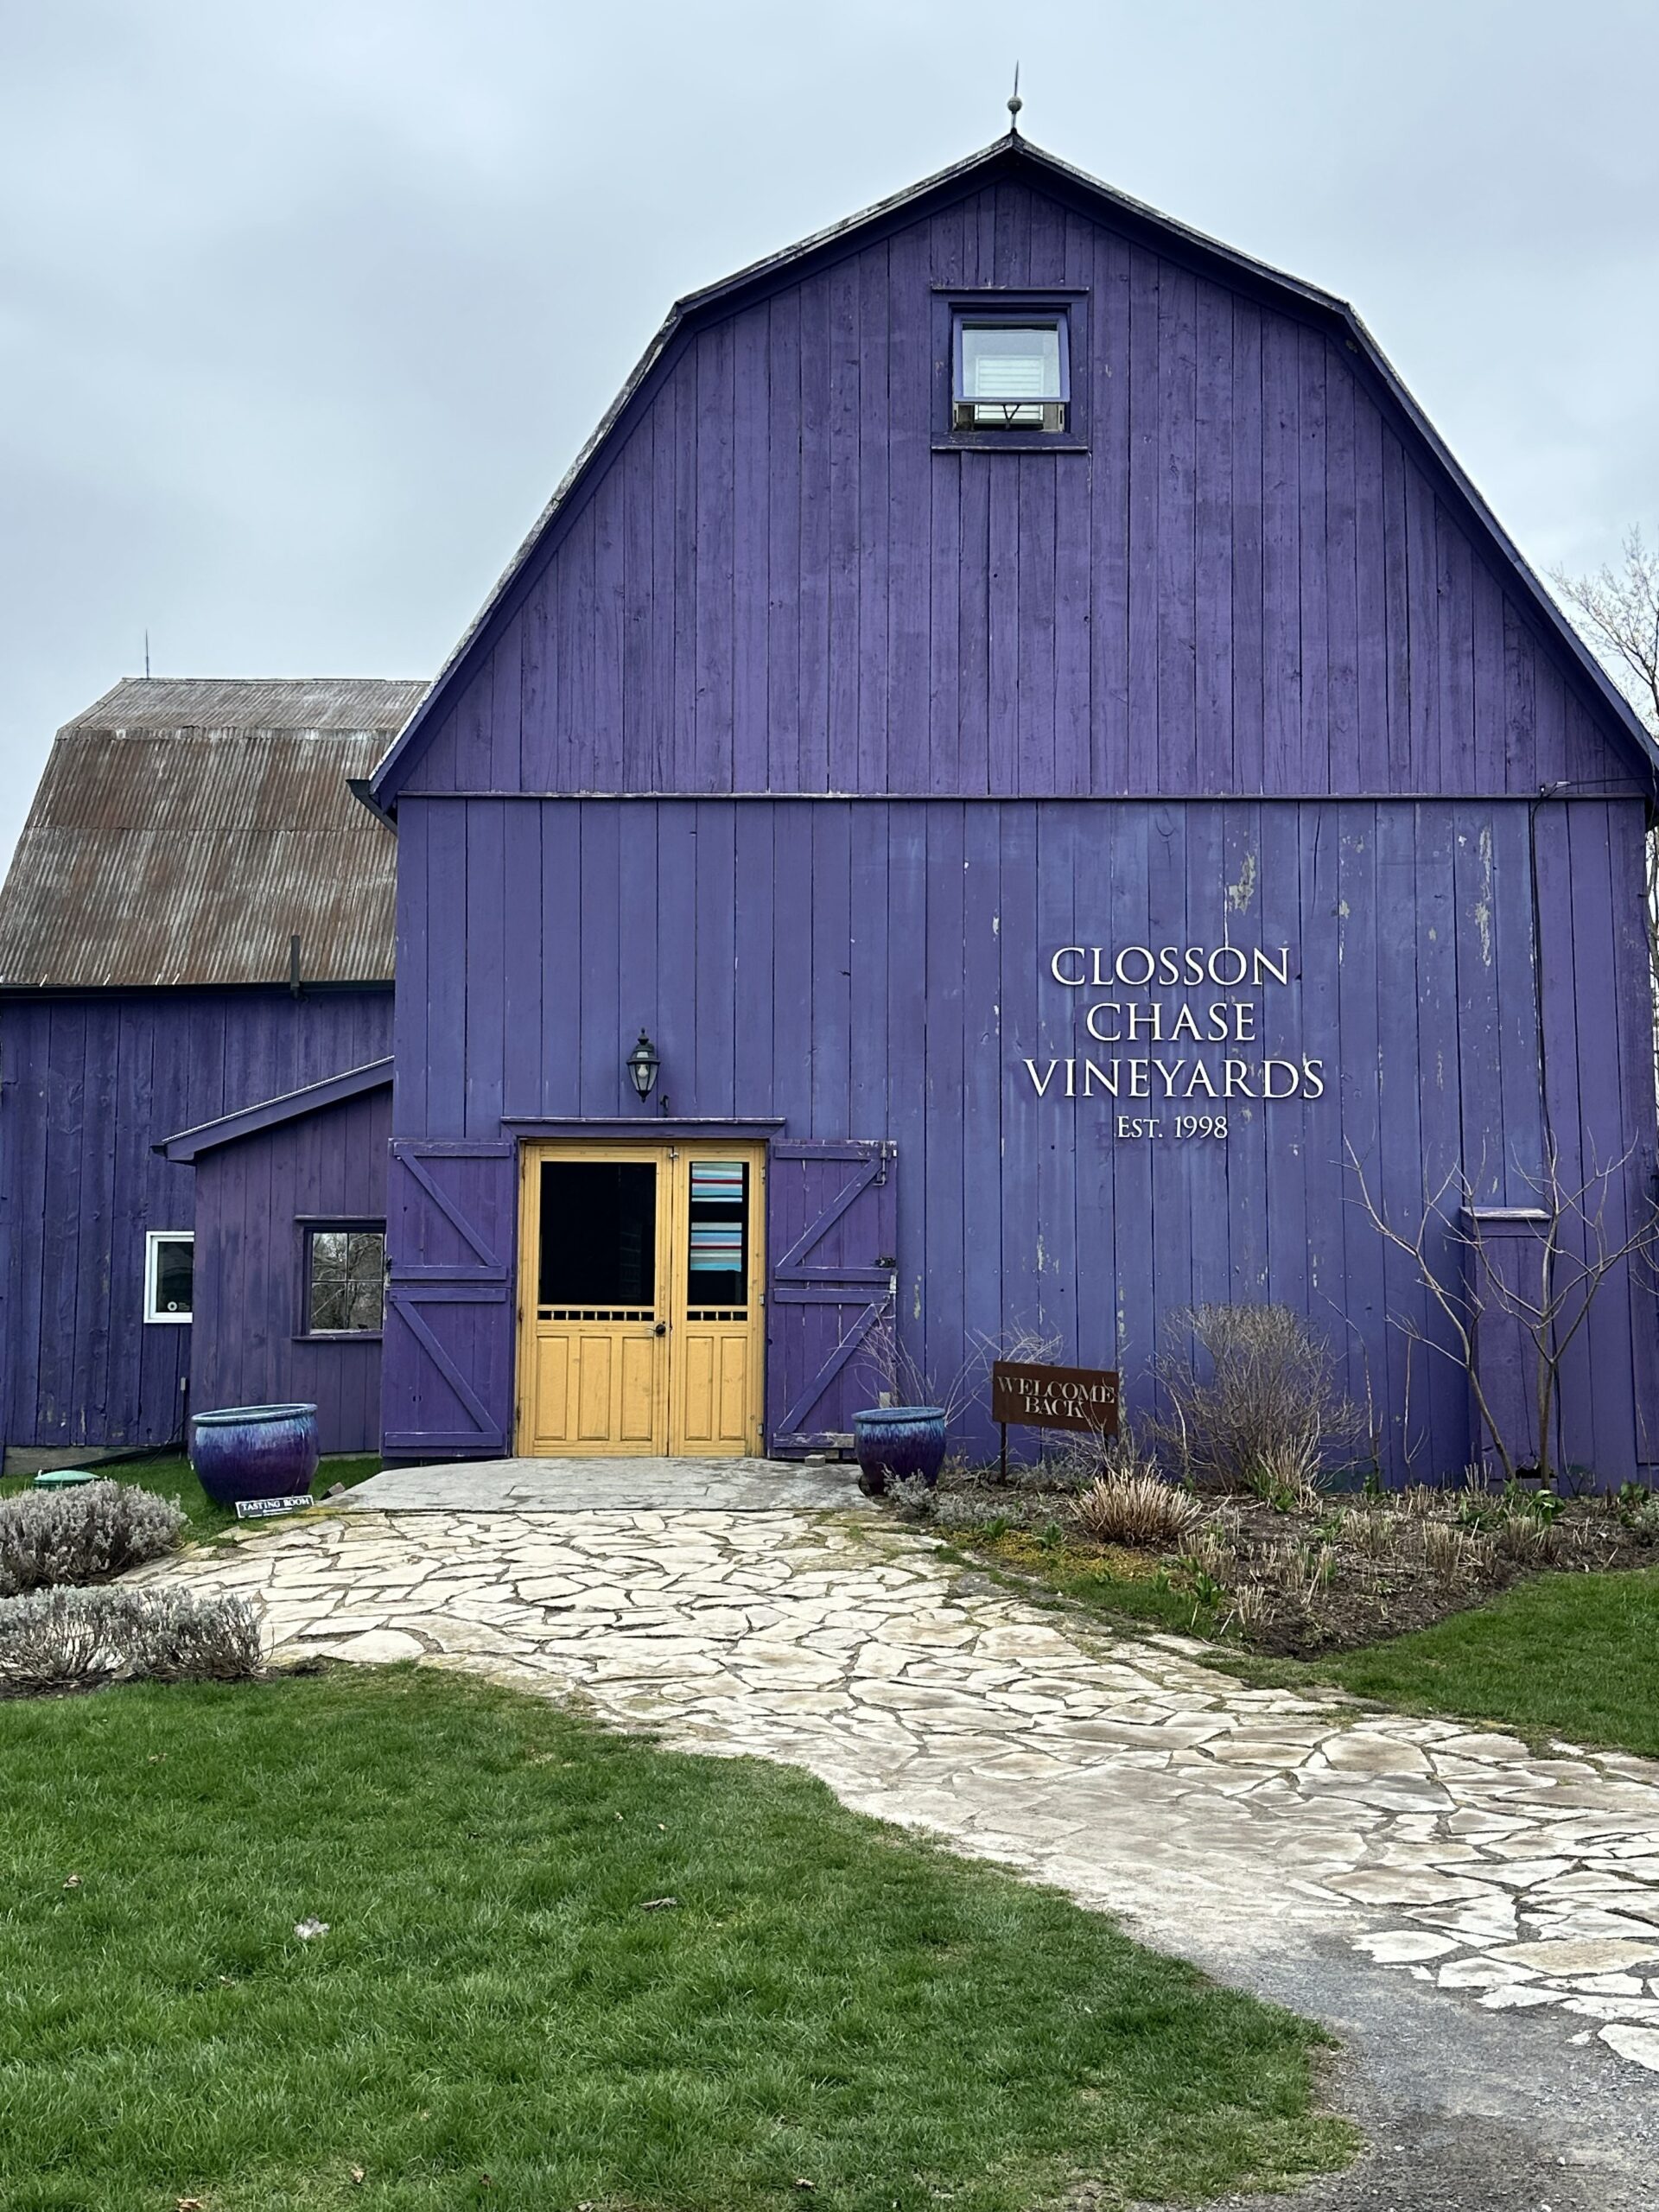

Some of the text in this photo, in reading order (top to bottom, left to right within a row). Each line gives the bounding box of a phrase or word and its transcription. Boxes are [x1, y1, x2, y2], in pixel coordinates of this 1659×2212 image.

[1051, 946, 1290, 986] CLOSSON
[1086, 1002, 1256, 1042] CHASE
[1023, 1058, 1325, 1099] VINEYARDS
[1116, 1116, 1229, 1139] EST. 1998
[997, 1376, 1115, 1403] WELCOME
[1025, 1396, 1084, 1418] BACK
[242, 1501, 280, 1510] TASTING
